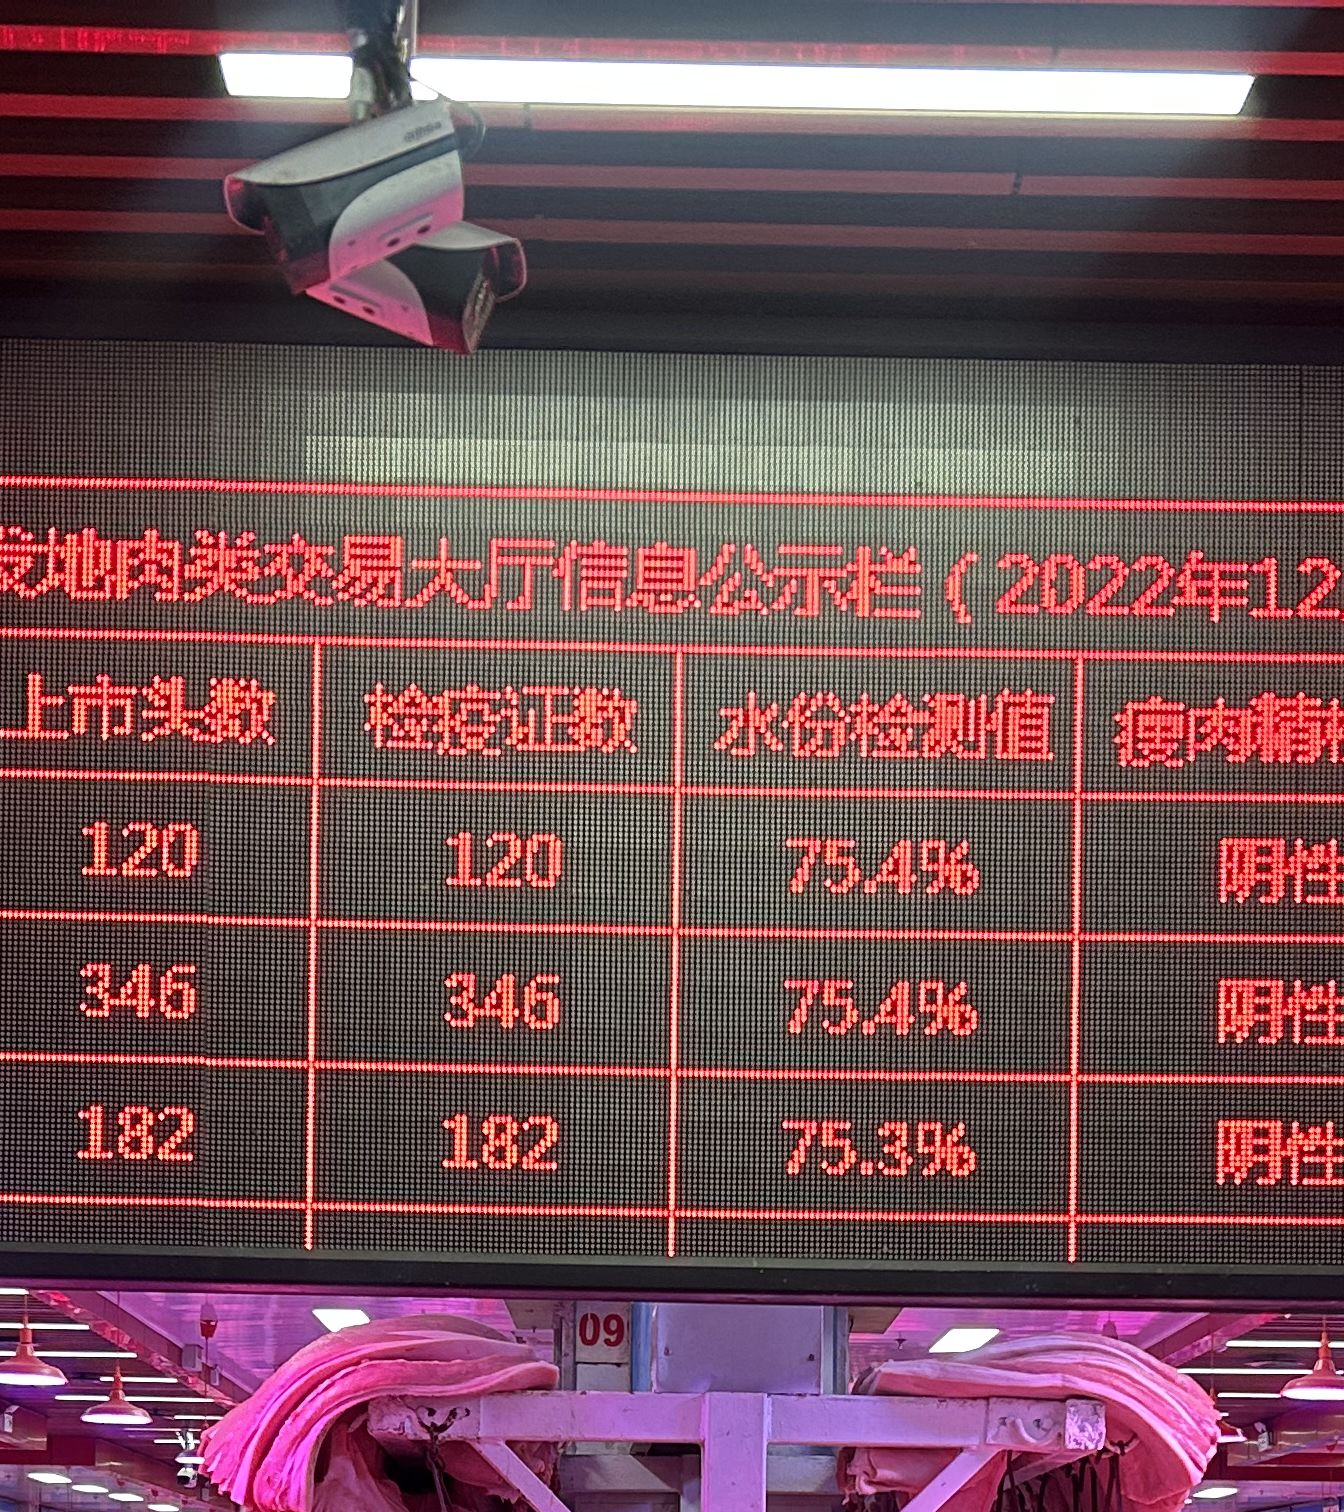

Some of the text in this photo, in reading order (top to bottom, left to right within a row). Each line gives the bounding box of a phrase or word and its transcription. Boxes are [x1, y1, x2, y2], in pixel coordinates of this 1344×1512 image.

[364, 682, 638, 758] 检疫证数
[713, 688, 1056, 764] 水份检测值
[82, 821, 200, 878] 120
[446, 831, 564, 890] 120
[786, 837, 979, 896] 75.4%
[80, 962, 195, 1019] 346
[444, 972, 559, 1030] 346
[784, 978, 979, 1036] 75.4%
[77, 1104, 193, 1161] 182
[442, 1113, 559, 1171] 182
[782, 1119, 977, 1178] 75.3%
[579, 1312, 625, 1347] 09
